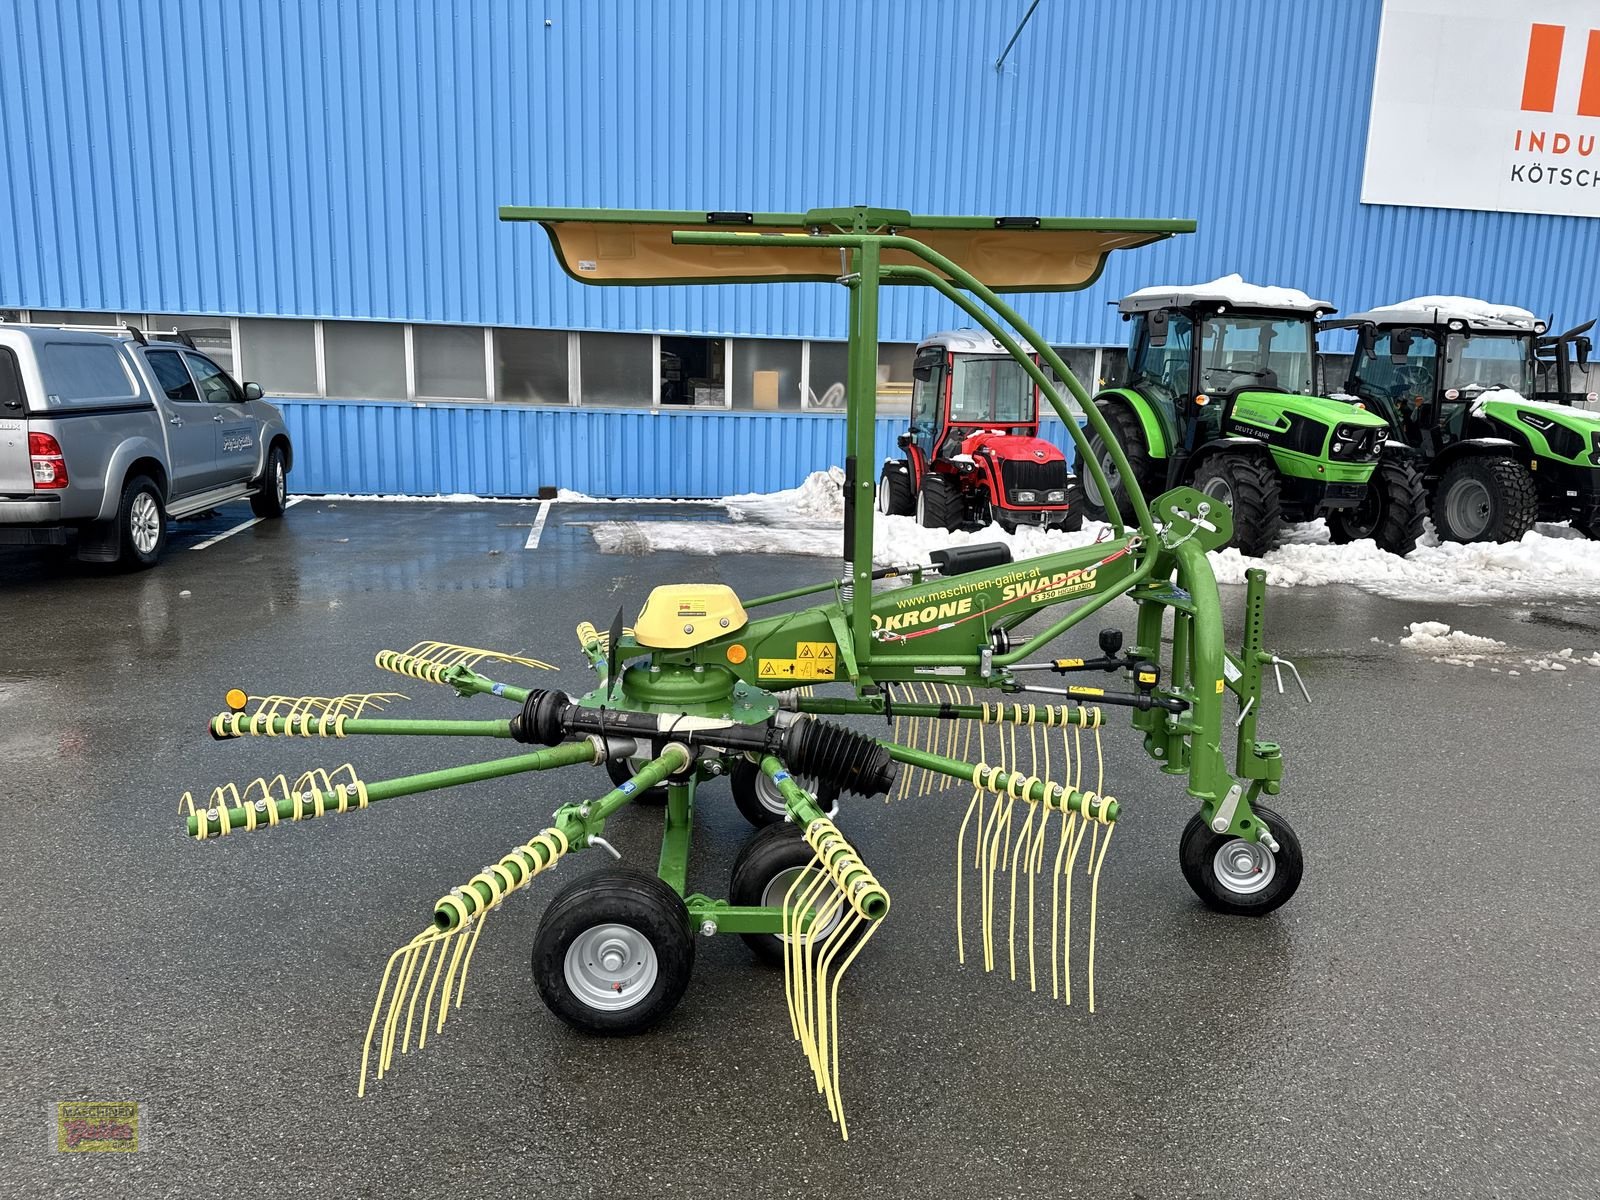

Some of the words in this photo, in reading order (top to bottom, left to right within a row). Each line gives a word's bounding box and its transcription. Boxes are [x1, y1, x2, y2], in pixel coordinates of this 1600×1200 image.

[1514, 130, 1595, 156] INDU
[896, 566, 1041, 609] www.maschinen-gailer.at
[1002, 568, 1097, 601] SWADRO
[1041, 590, 1056, 600] 350
[885, 598, 972, 631] KRONE
